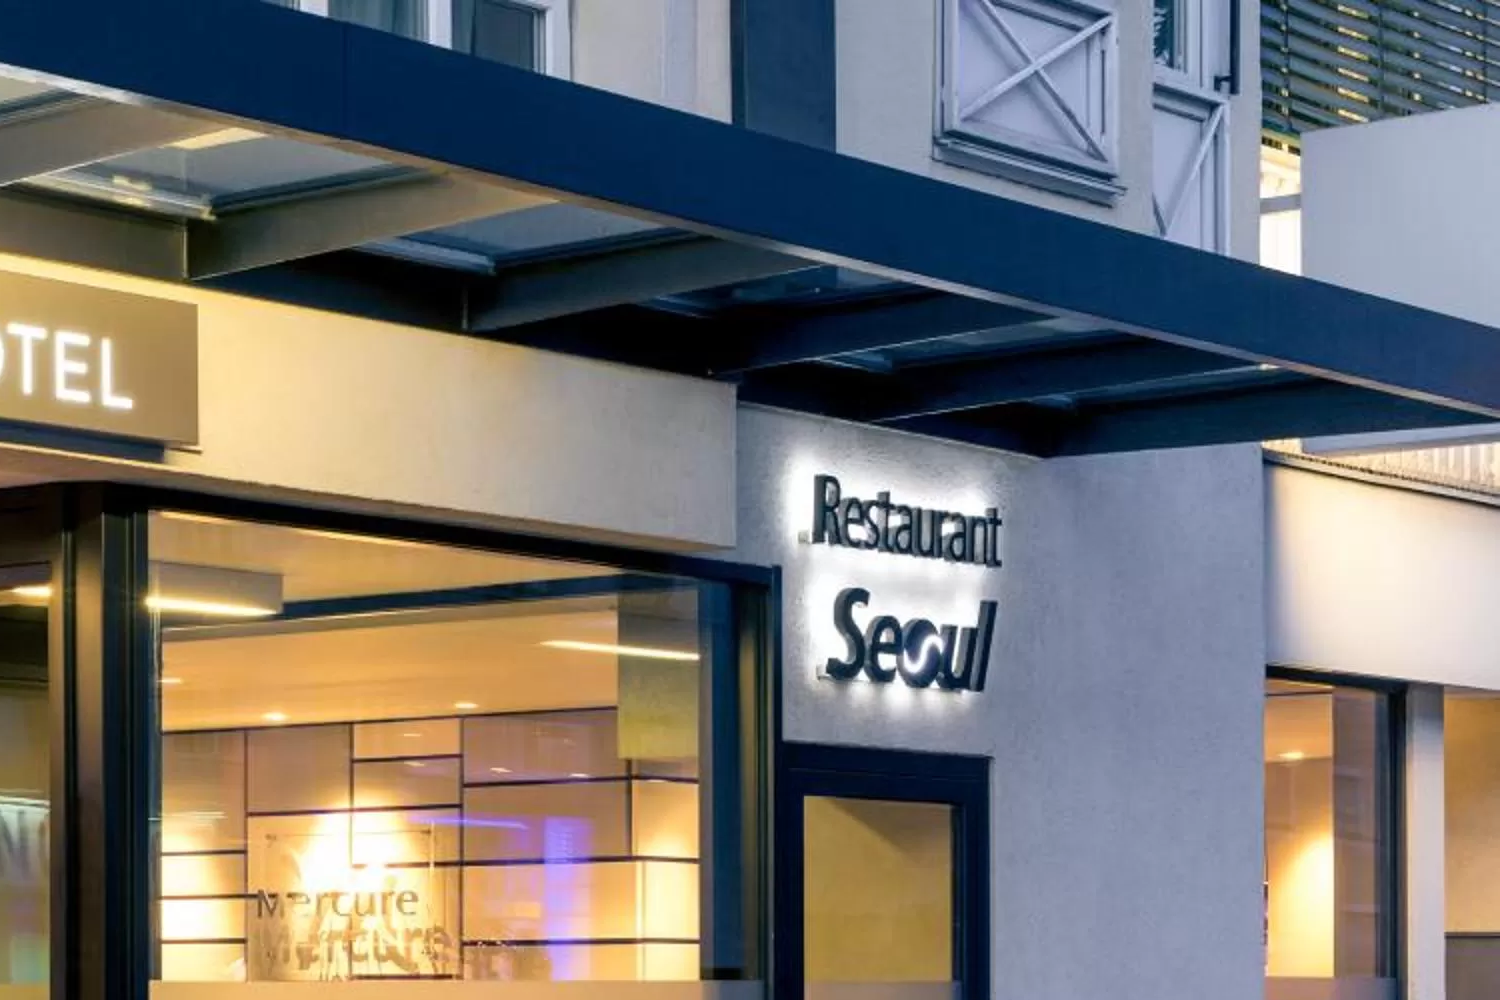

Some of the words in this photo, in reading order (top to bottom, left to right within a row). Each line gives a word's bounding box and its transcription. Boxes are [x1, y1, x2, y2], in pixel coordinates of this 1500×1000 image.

[811, 473, 1002, 568] Restaurant
[825, 587, 998, 692] Seoul
[256, 888, 420, 918] Mercure
